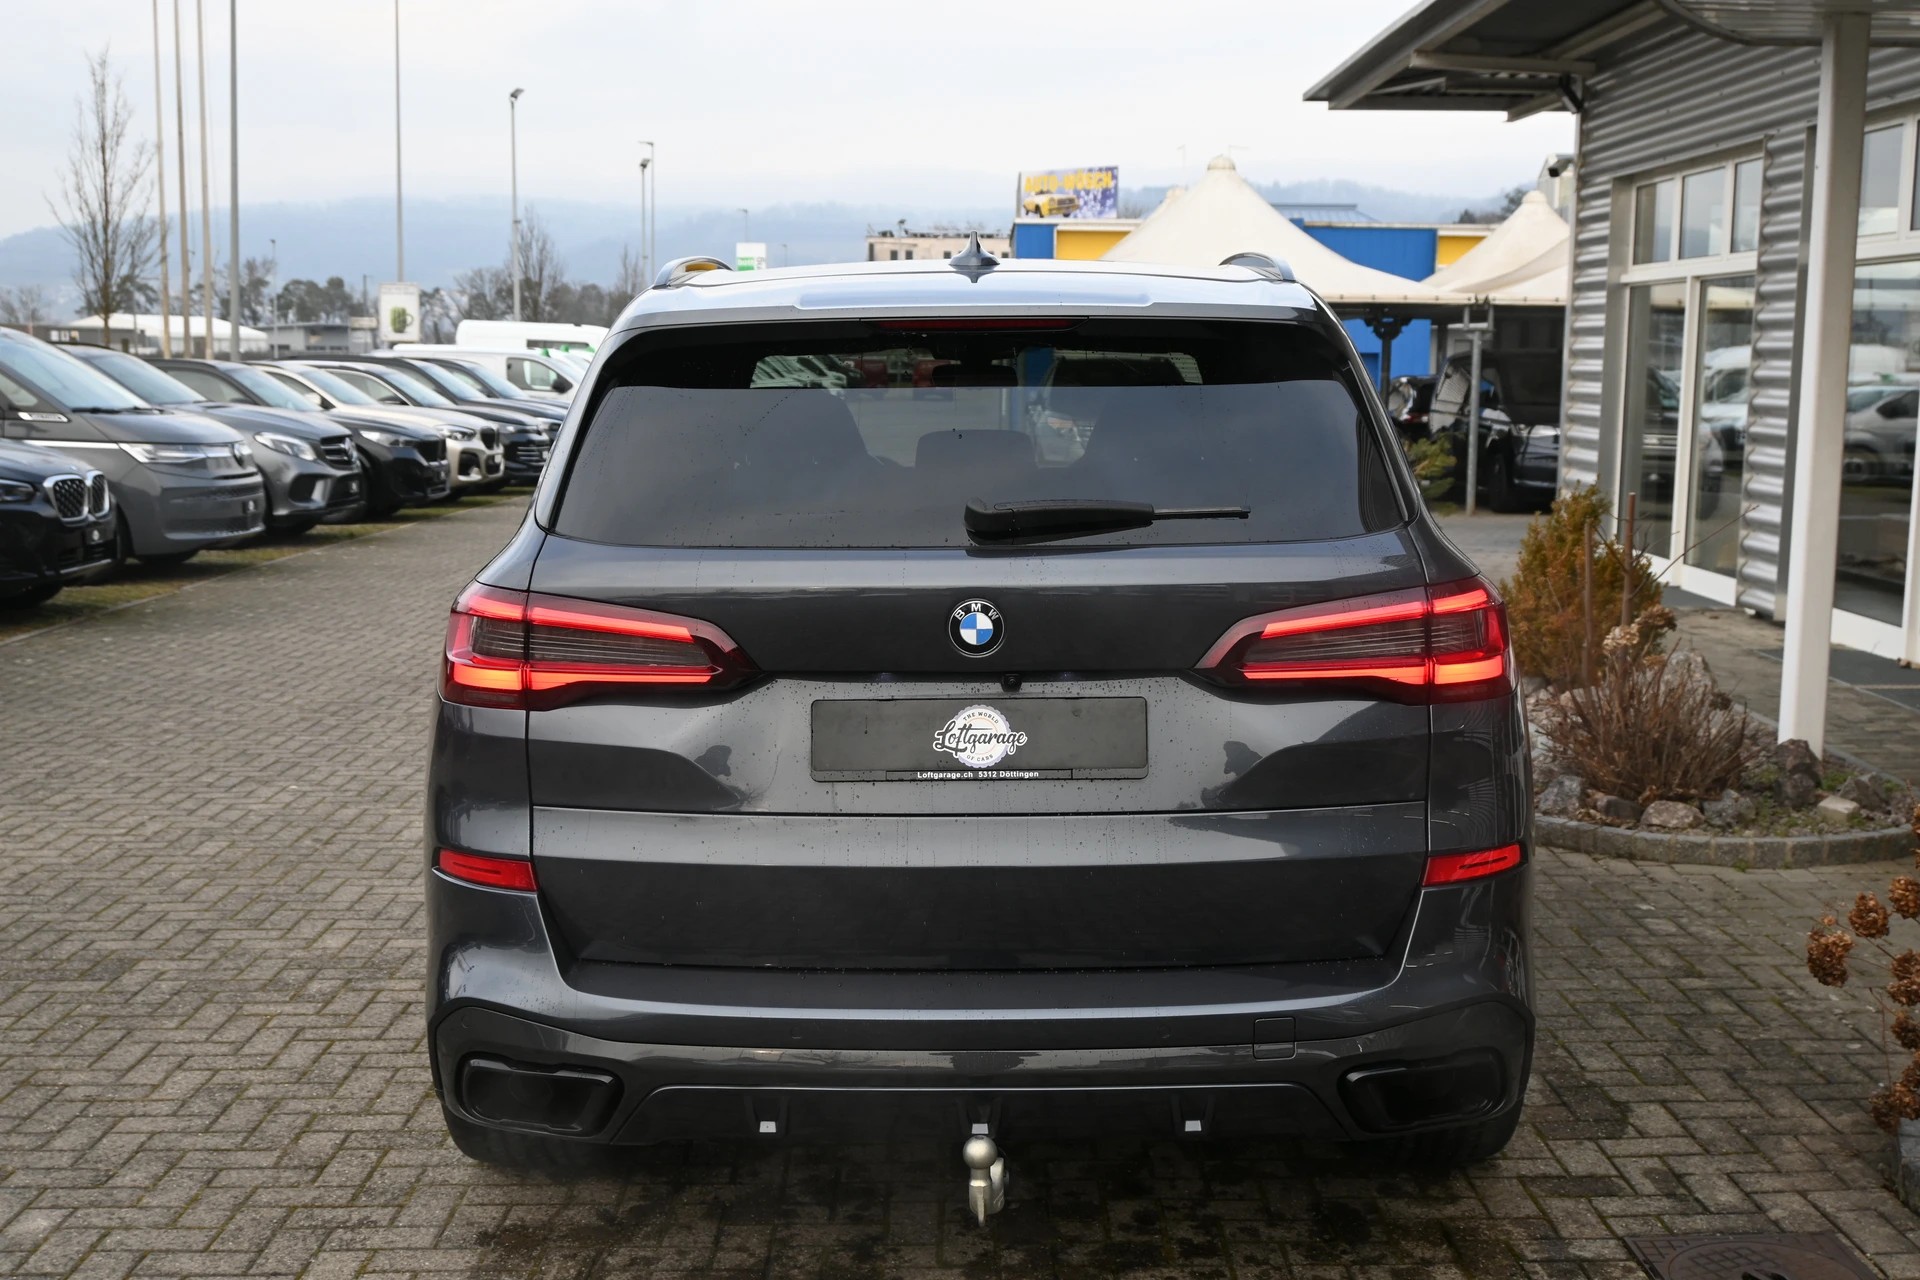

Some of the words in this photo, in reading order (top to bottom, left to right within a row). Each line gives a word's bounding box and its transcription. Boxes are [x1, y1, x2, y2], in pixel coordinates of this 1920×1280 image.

[1024, 168, 1112, 192] AUTO-WÖSCH
[954, 603, 999, 621] BMW
[962, 712, 976, 721] THE
[978, 711, 999, 724] WORLD
[934, 720, 1027, 756] Loftgarage
[977, 754, 994, 762] CARS
[917, 771, 973, 779] Loftgarage.ch
[999, 770, 1039, 779] Döttingen
